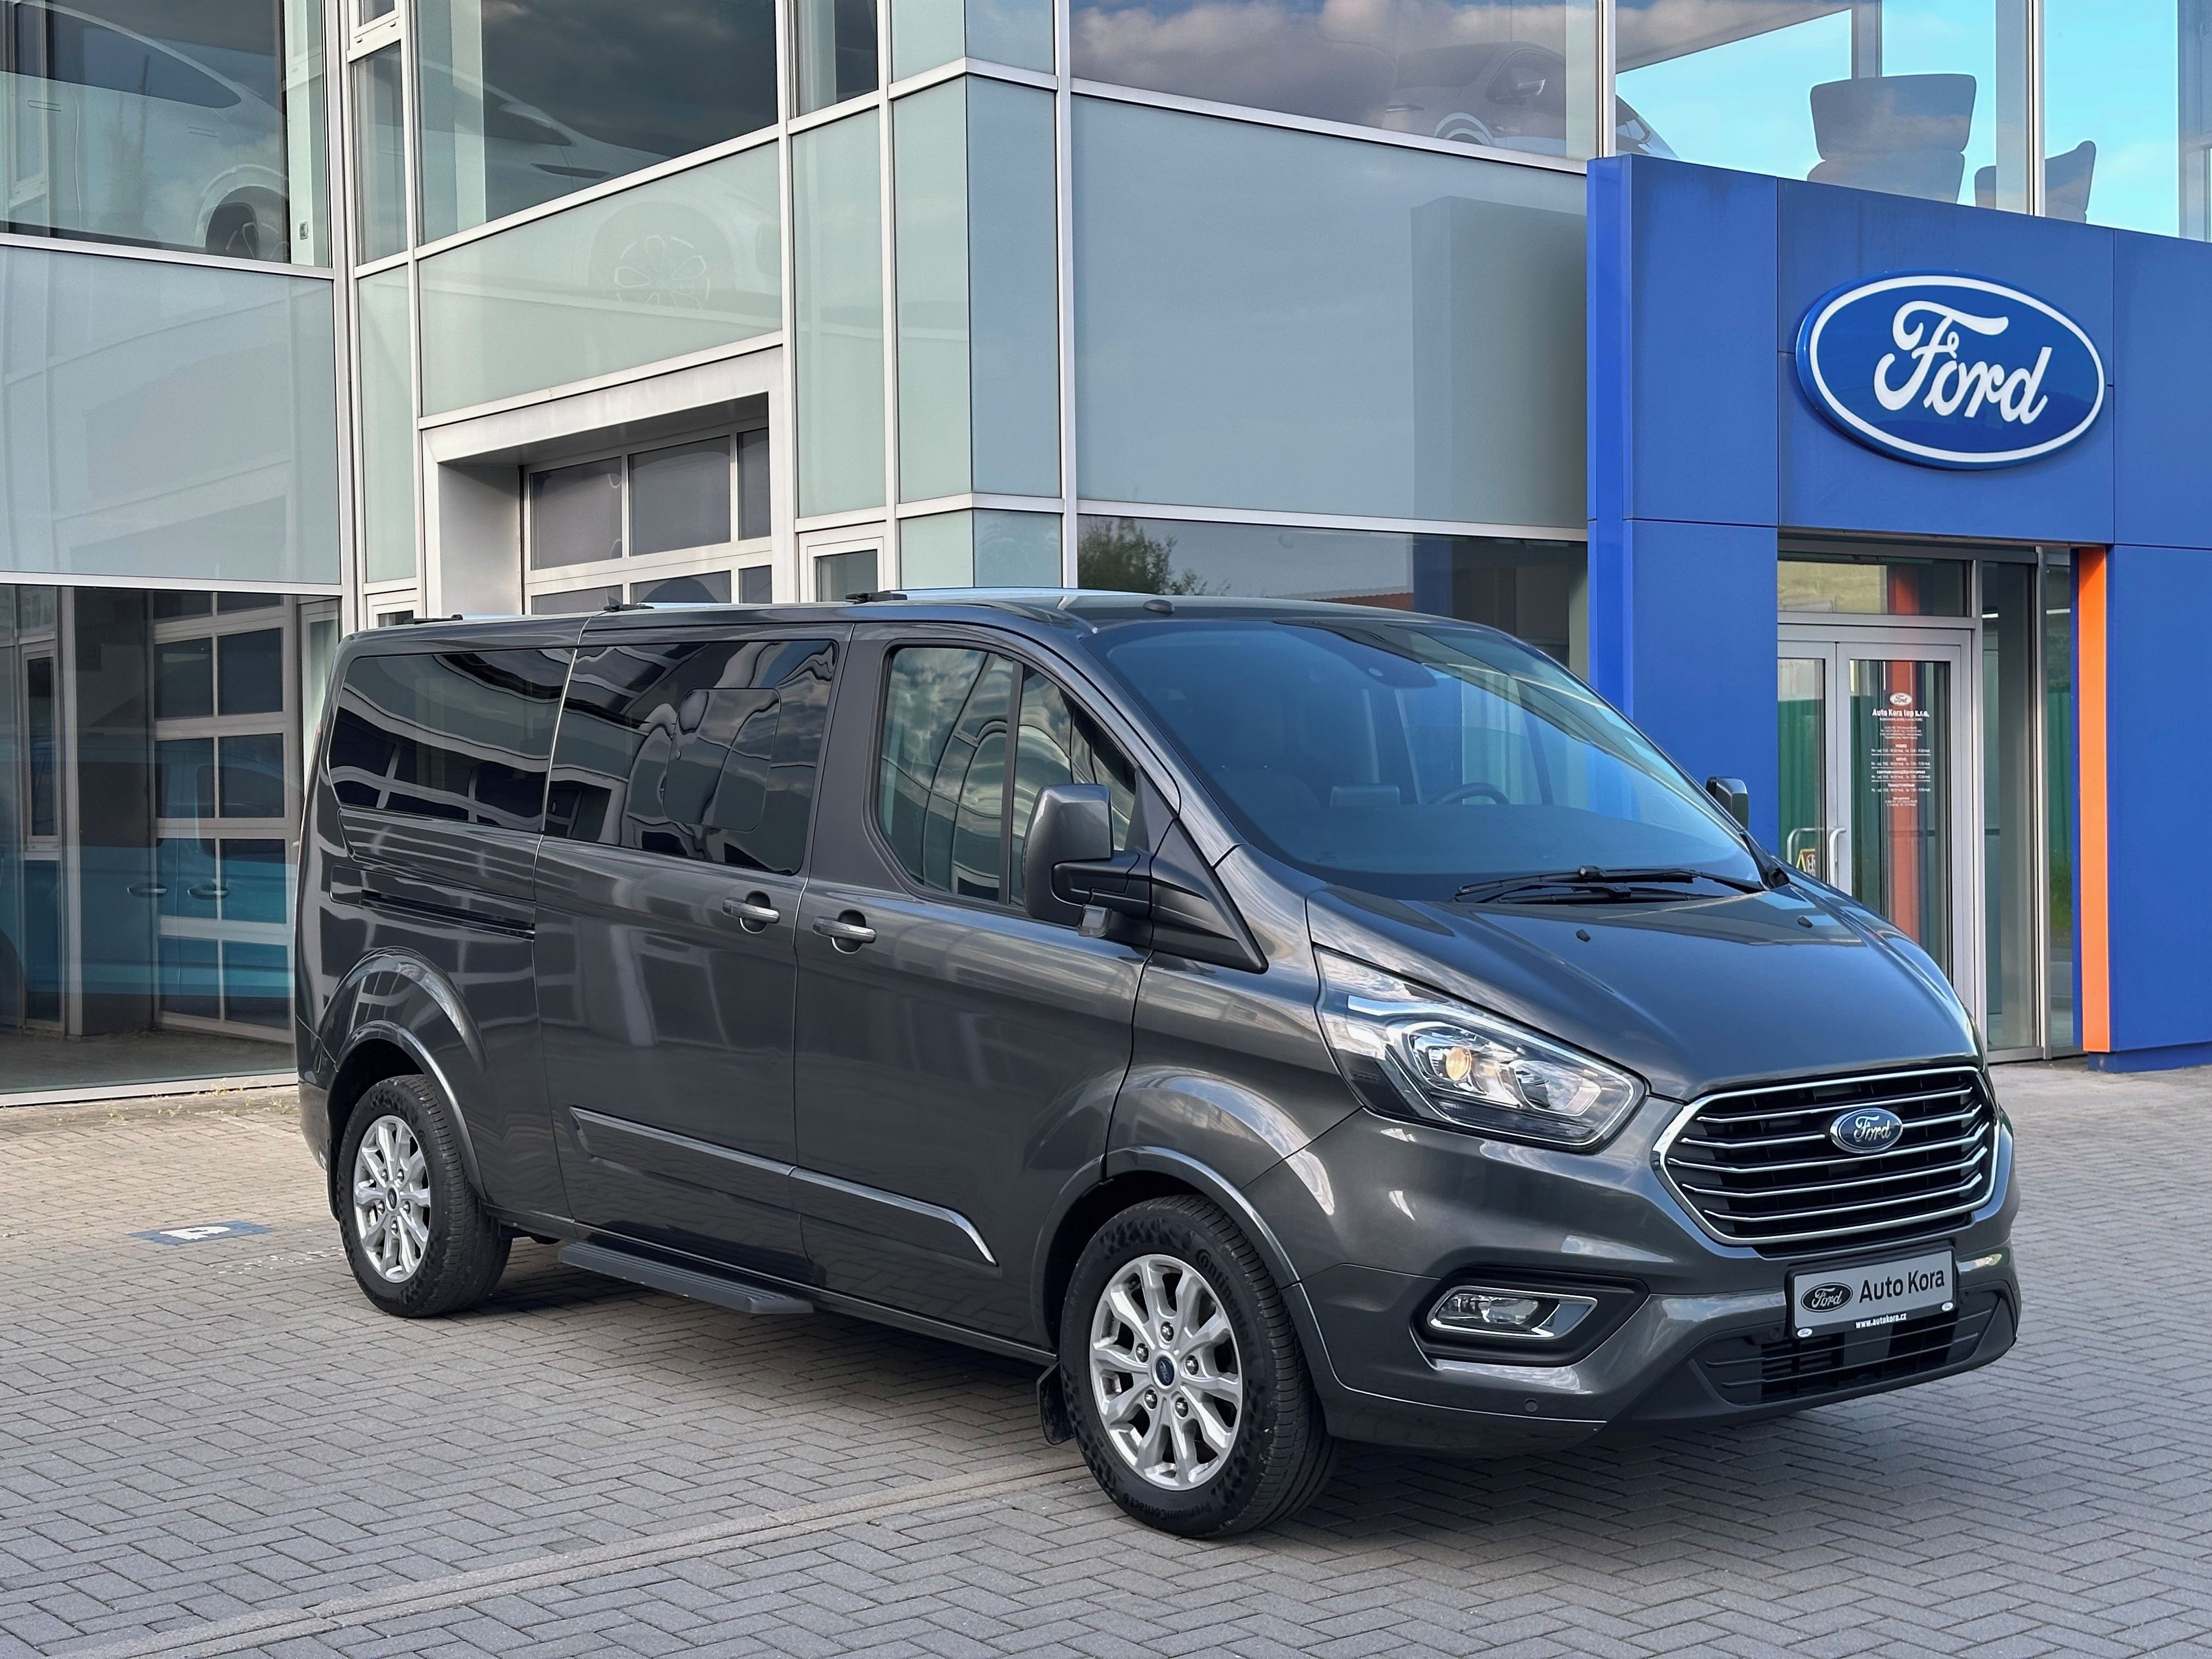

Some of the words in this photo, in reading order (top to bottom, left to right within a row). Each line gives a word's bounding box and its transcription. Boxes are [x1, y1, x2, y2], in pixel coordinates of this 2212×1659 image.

[1874, 300, 2052, 425] Ford
[1894, 695, 1908, 703] Ford
[1853, 1115, 1891, 1142] Ford
[1812, 1287, 1843, 1308] Ford
[1859, 1277, 1903, 1304] Auto
[1908, 1269, 1945, 1294] Kora
[1855, 1313, 1906, 1329] www.autokora.cz
[1123, 1492, 1130, 1505] 6
